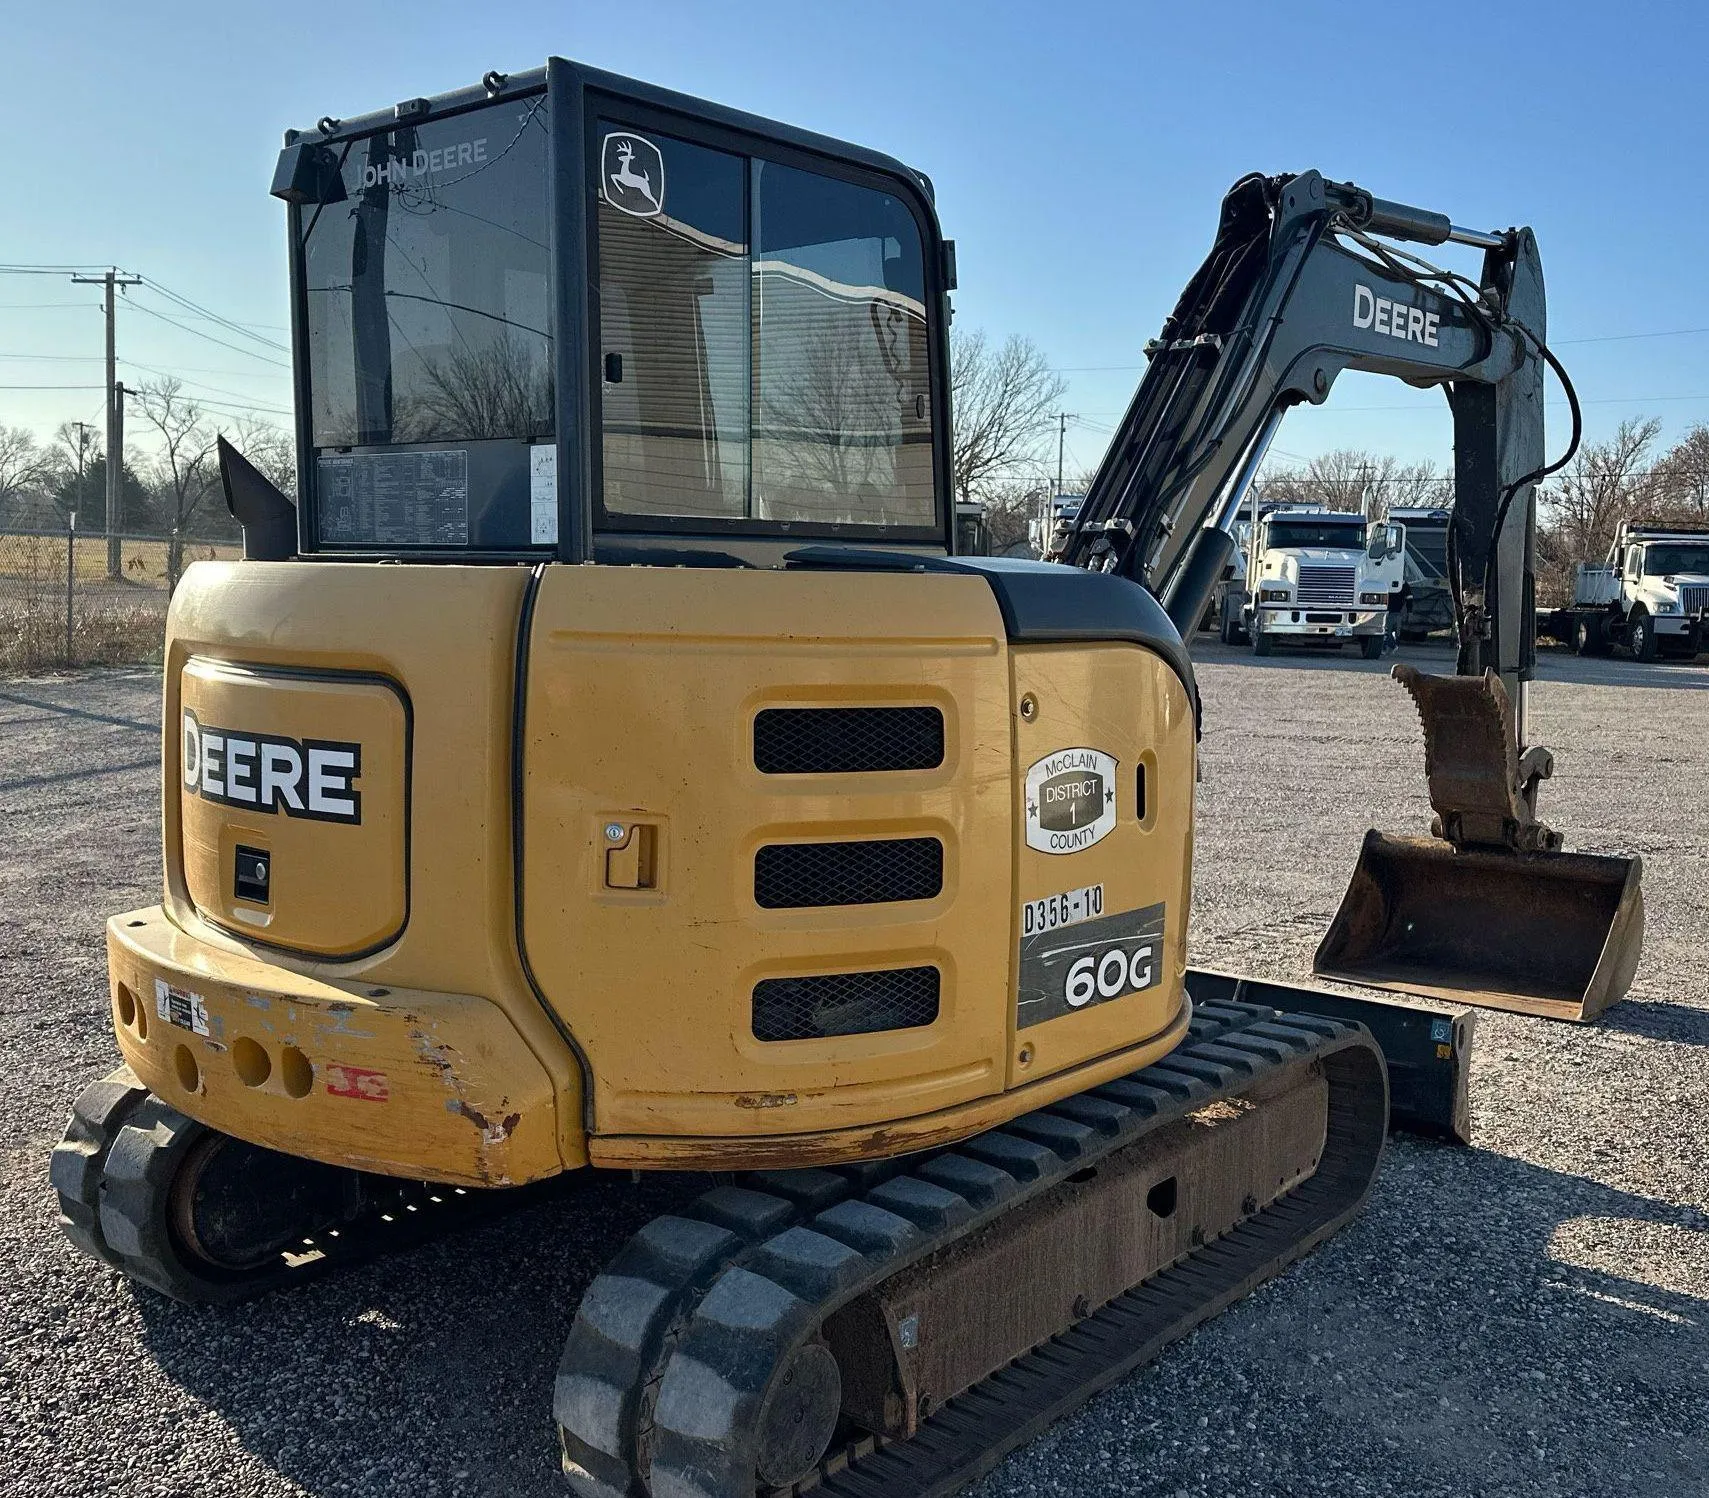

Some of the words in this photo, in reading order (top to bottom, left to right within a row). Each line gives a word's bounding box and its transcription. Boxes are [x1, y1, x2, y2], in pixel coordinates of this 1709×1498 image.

[355, 157, 407, 191] JOHN
[413, 139, 487, 177] DEERE
[1353, 284, 1440, 347] DEERE
[184, 714, 354, 816] DEERE
[1046, 753, 1097, 778] McCLAIN
[1046, 780, 1097, 803] DISTRICT
[1069, 802, 1076, 825] 1
[1050, 824, 1096, 849] COUNTY
[1024, 885, 1103, 934] D356-10
[1065, 946, 1152, 1007] 60G
